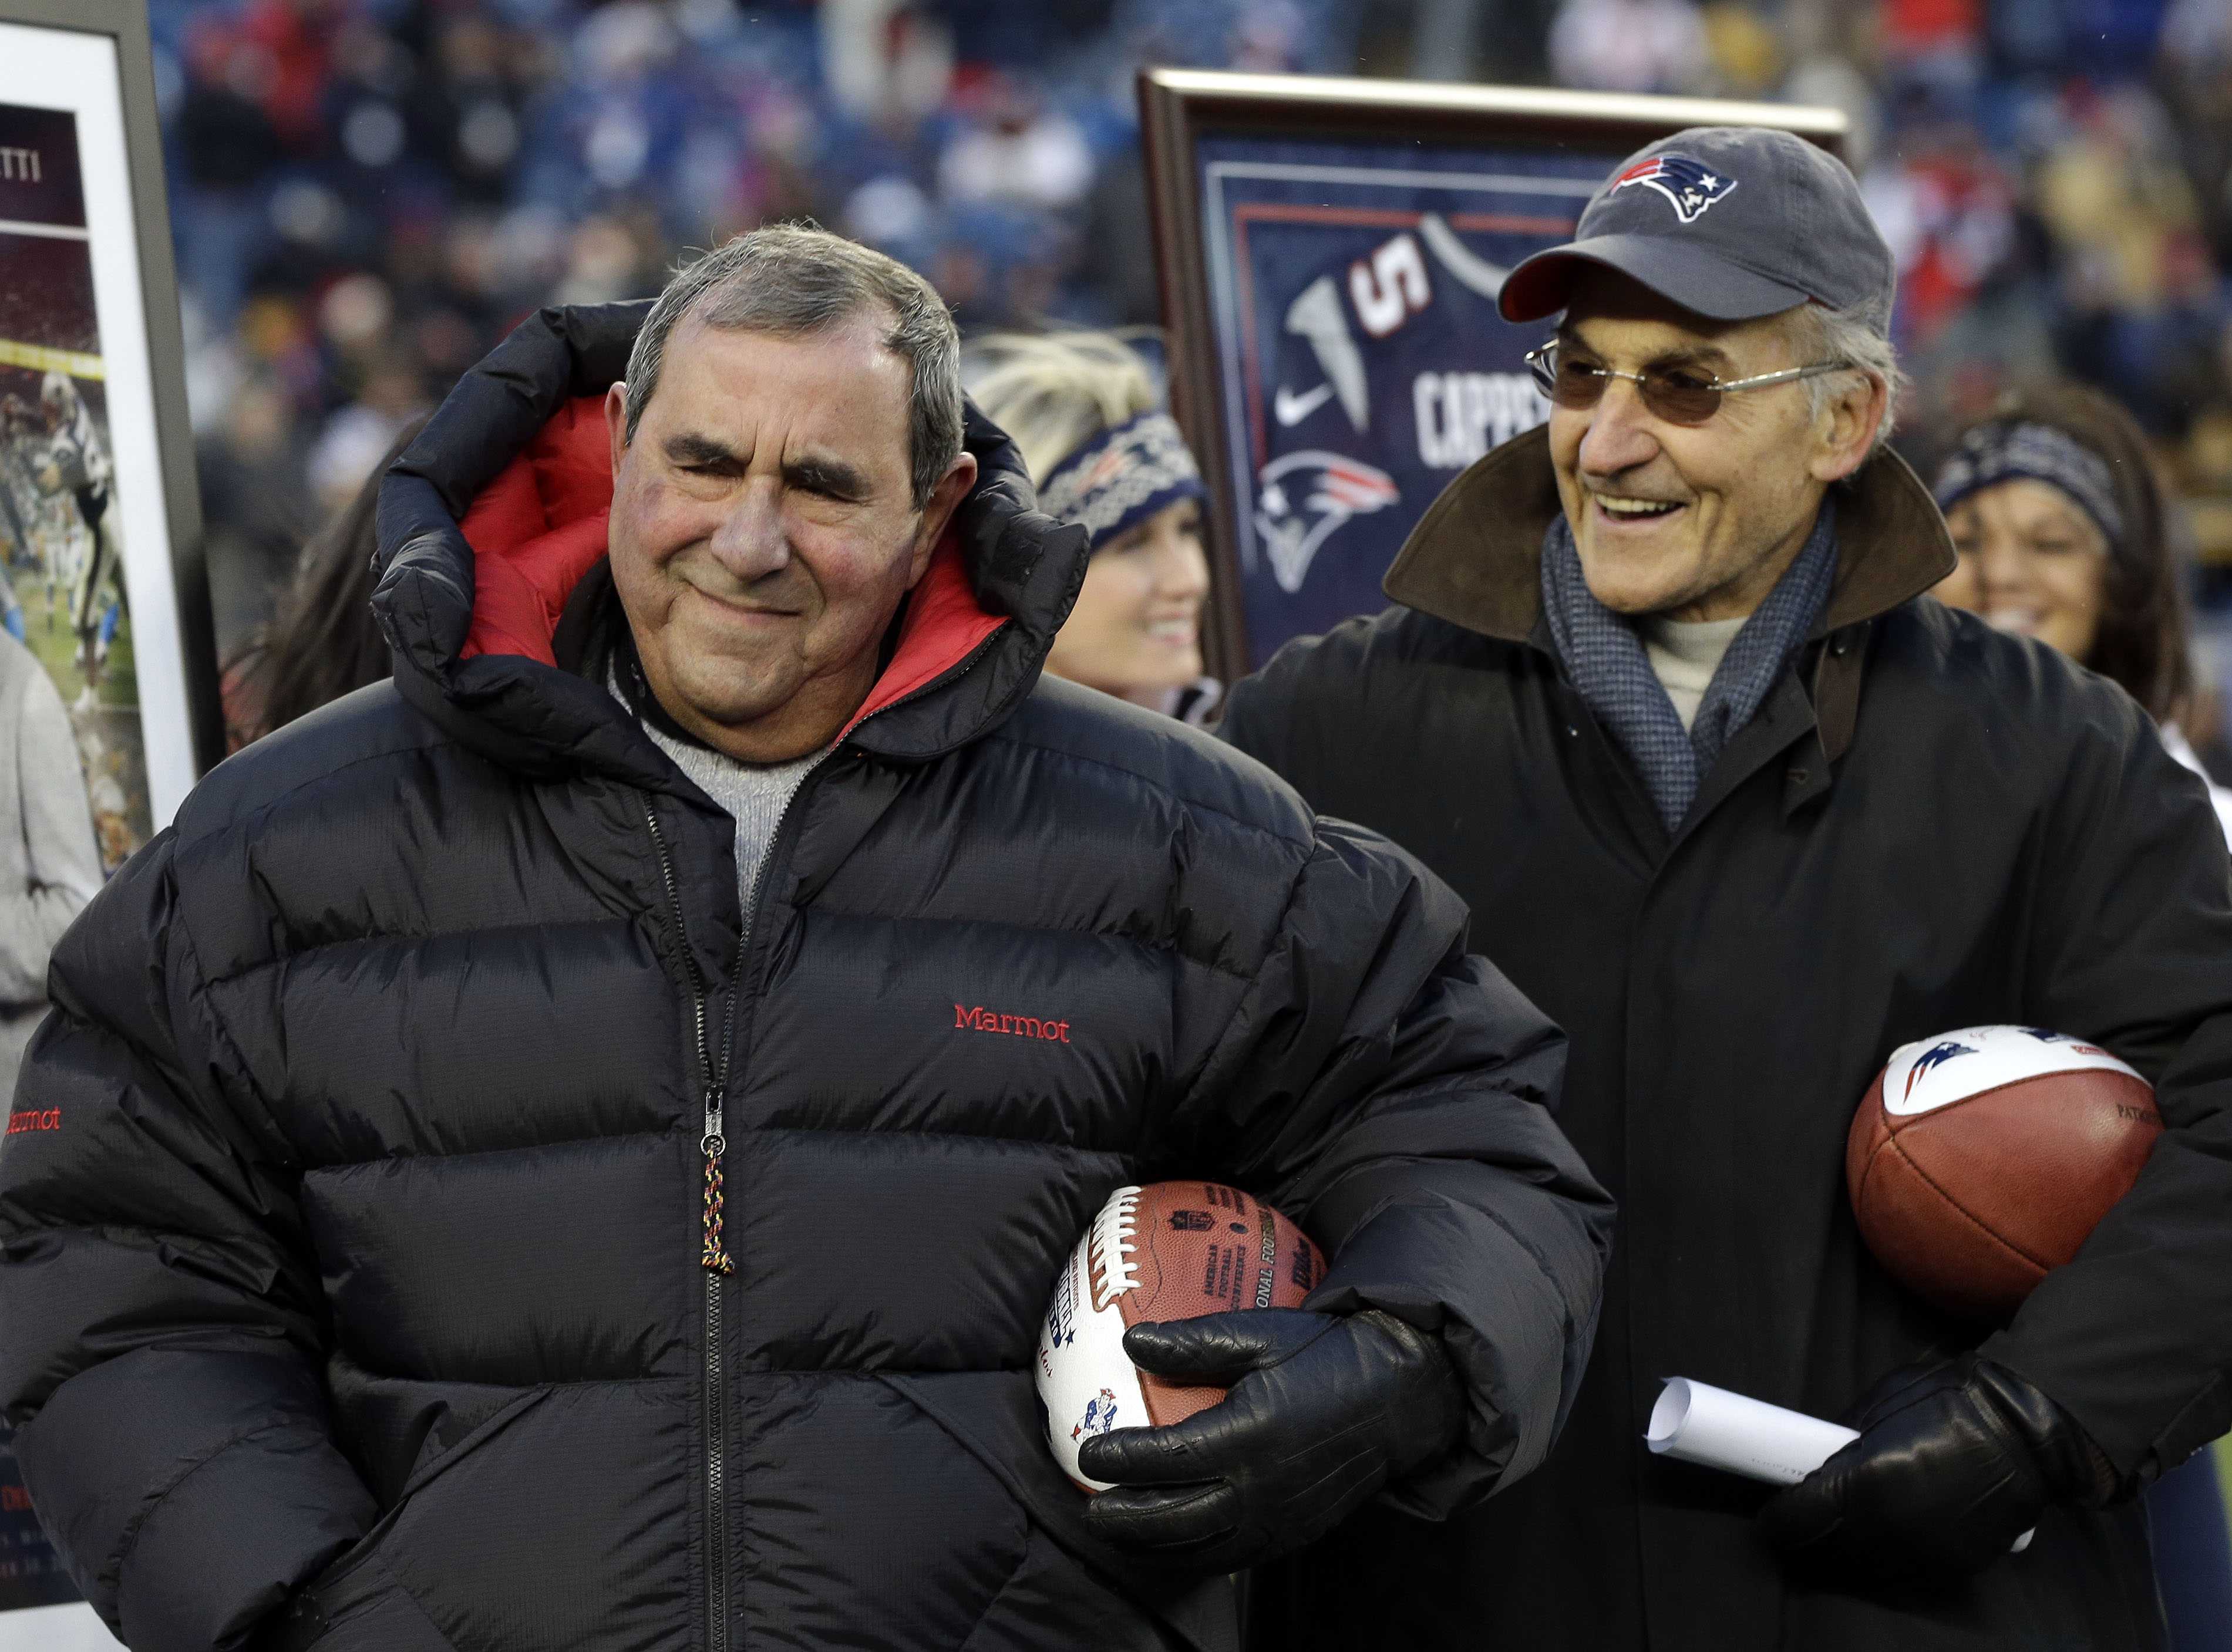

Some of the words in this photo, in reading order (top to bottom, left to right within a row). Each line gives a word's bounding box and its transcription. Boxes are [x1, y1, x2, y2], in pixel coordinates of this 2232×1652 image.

[0, 146, 42, 182] TTI
[954, 1003, 1070, 1043] Marmot
[1205, 1245, 1217, 1296] AMERICAN
[1218, 1249, 1231, 1298] FOOTBALL
[1255, 1268, 1274, 1308] ONAL
